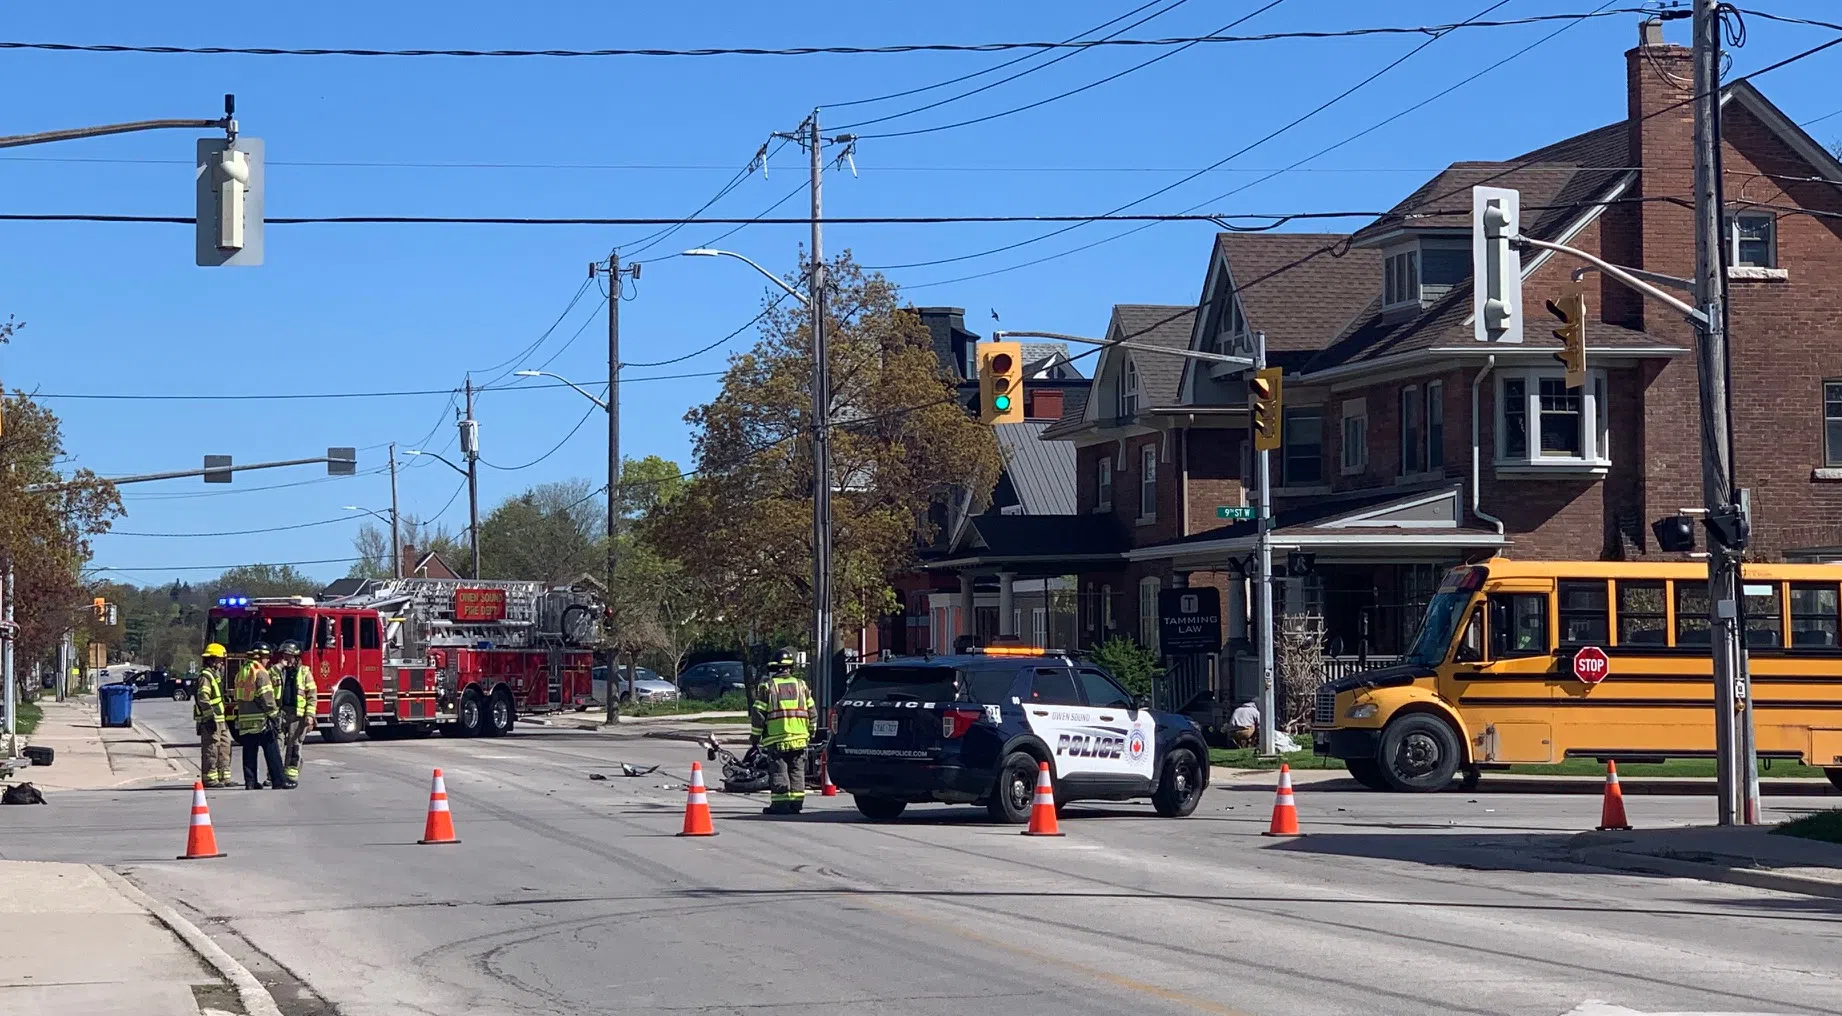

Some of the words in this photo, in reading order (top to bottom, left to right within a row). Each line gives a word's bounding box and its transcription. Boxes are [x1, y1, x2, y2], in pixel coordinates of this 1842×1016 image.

[1234, 508, 1243, 516] ST
[1244, 508, 1250, 516] W
[460, 592, 478, 602] OWEN
[480, 592, 503, 602] SOUND
[464, 606, 479, 616] FIRE
[1164, 616, 1218, 624] TAMMING
[1178, 626, 1202, 634] LAW
[1578, 658, 1604, 672] STOP
[1052, 712, 1070, 720] OWEN
[1070, 713, 1090, 722] SOUND
[1056, 734, 1124, 759] POLICE
[844, 748, 928, 757] WWW.OWENSOUNDPOLICE.COM
